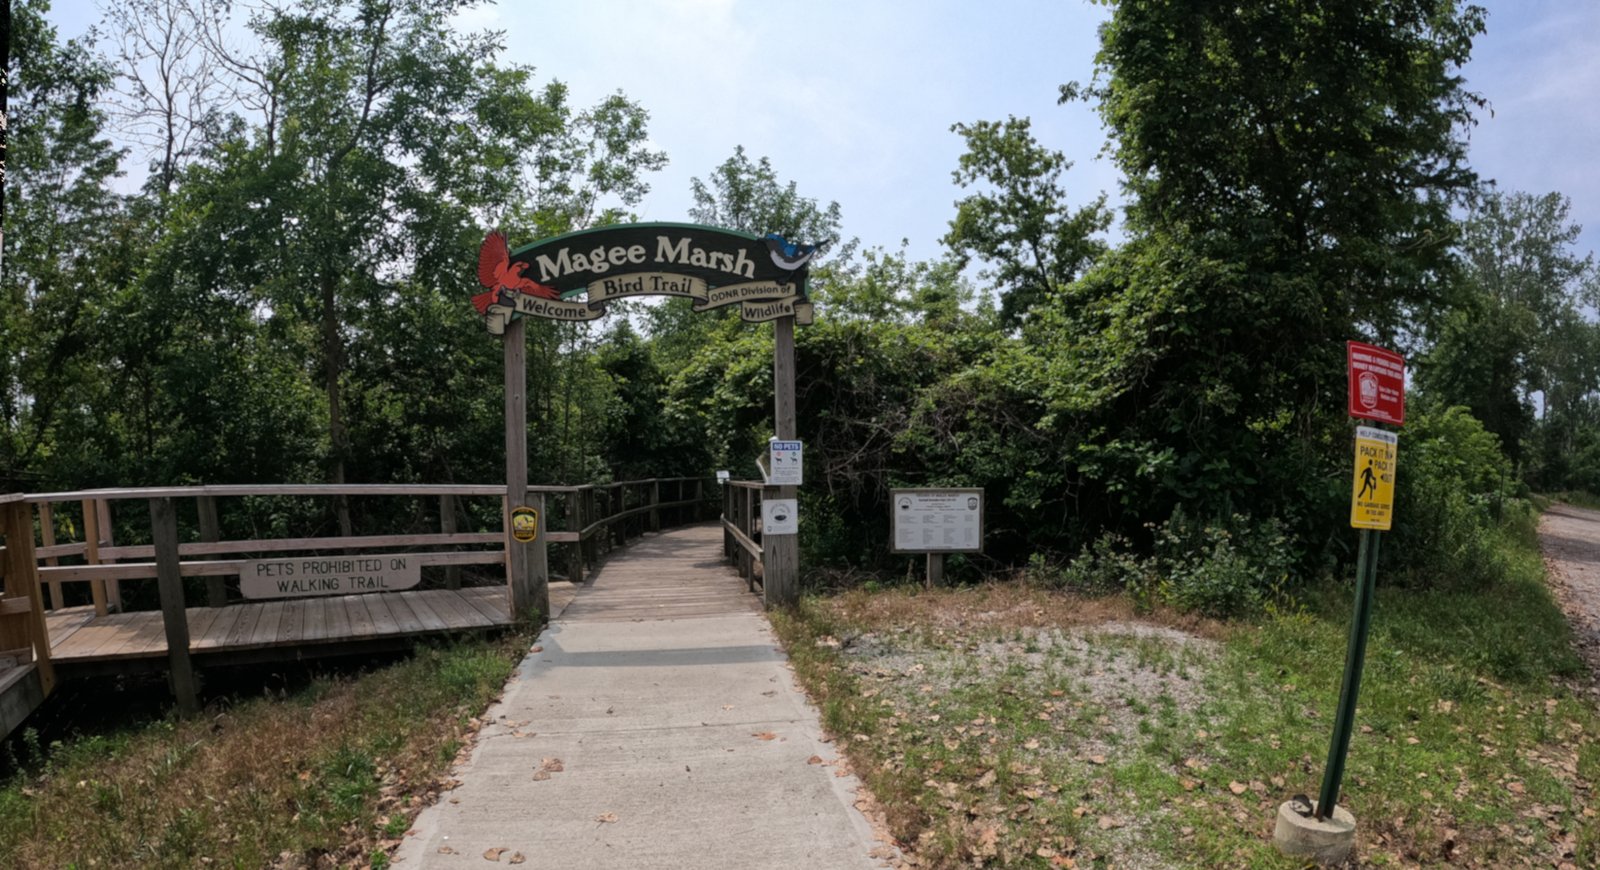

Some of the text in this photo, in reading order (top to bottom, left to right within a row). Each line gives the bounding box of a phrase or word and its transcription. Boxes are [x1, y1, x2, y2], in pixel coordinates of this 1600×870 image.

[535, 236, 755, 282] Magee Marsh
[603, 276, 692, 296] Bird Trail
[711, 285, 791, 302] ODNR Division of
[522, 298, 586, 318] Welcome
[743, 302, 791, 319] Wildlife
[1360, 446, 1377, 457] PACK
[1374, 460, 1387, 471] PACK
[256, 558, 407, 577] PETS PROHIBITED ON
[277, 575, 389, 593] WALKING TRAIL
